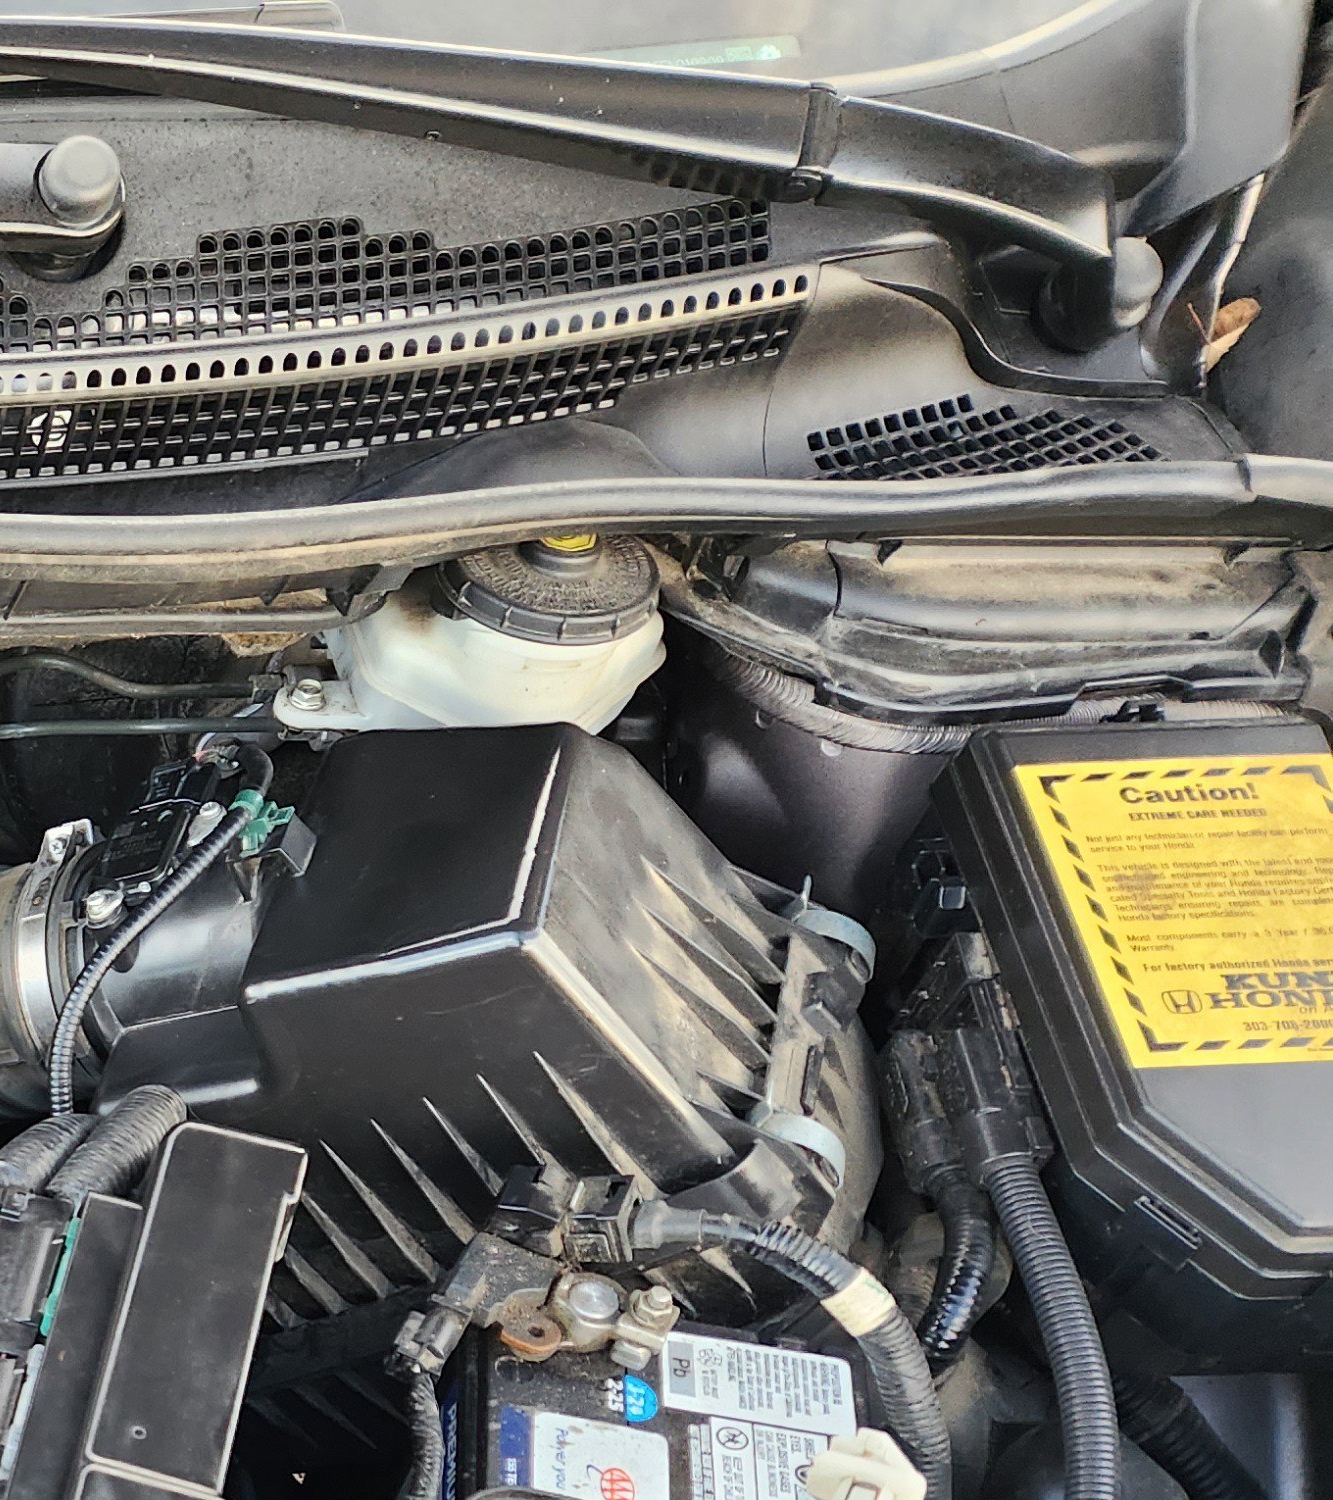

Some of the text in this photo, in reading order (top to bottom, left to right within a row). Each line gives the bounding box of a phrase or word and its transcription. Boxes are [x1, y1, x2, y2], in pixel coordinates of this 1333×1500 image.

[1119, 782, 1260, 805] Caution!
[1128, 810, 1183, 821] EXTREME
[1186, 809, 1218, 819] CARE
[1220, 970, 1333, 990] KUN
[672, 1358, 691, 1377] Pb
